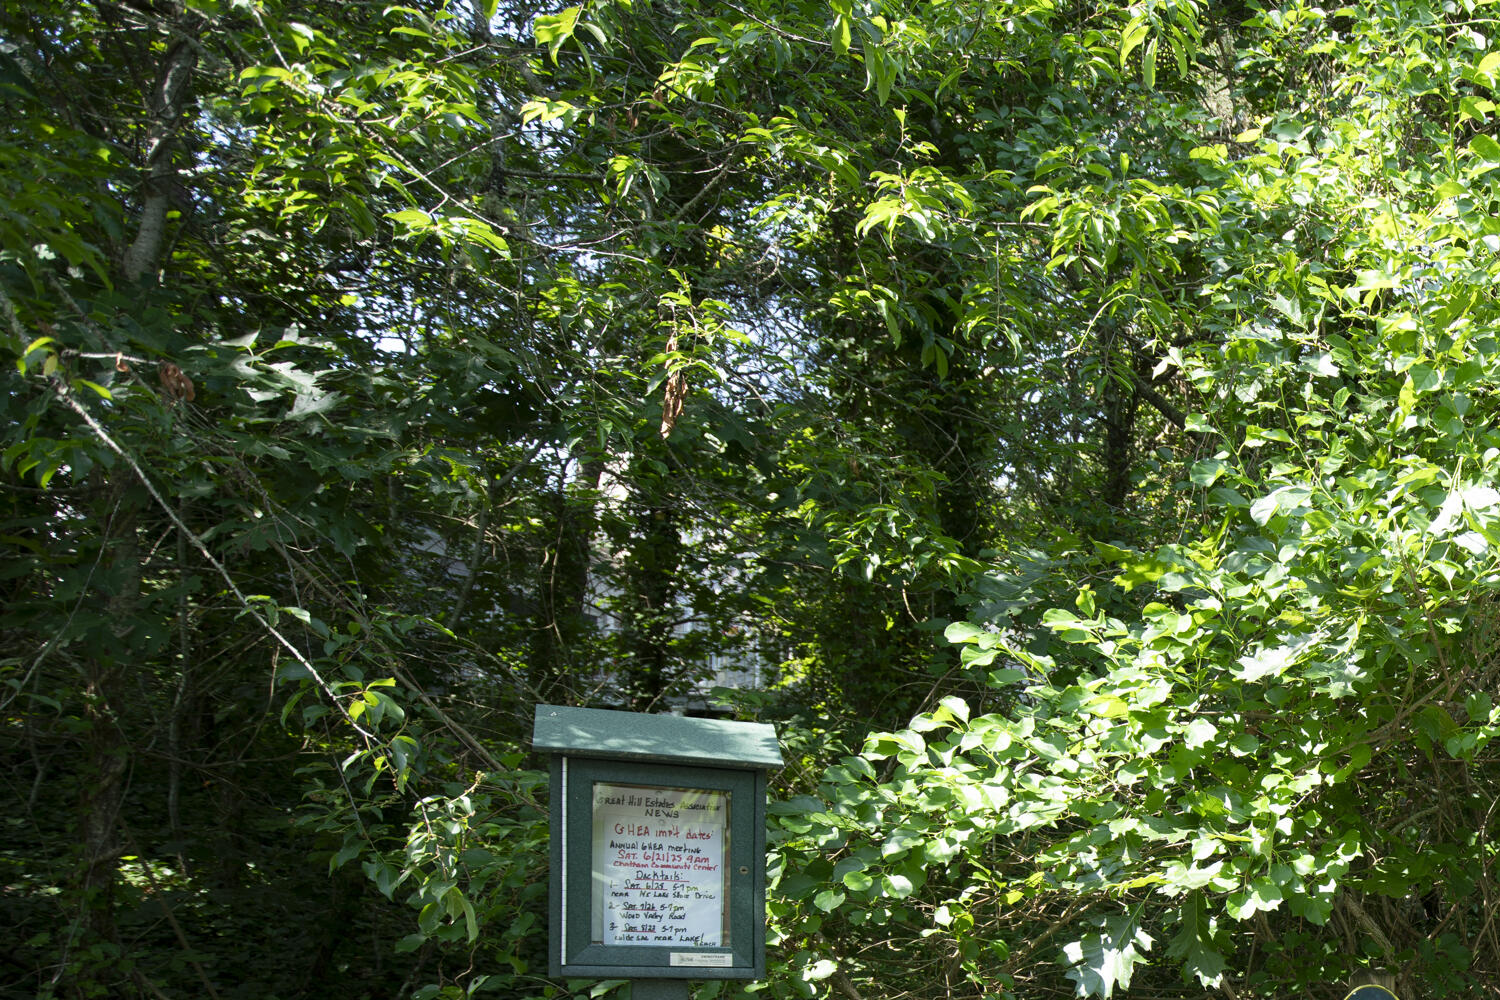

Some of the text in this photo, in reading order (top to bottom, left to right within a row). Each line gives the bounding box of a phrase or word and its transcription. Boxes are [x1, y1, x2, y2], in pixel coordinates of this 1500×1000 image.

[645, 808, 680, 819] NEWS
[614, 823, 650, 838] GHEA
[643, 851, 682, 863] 6/21/25
